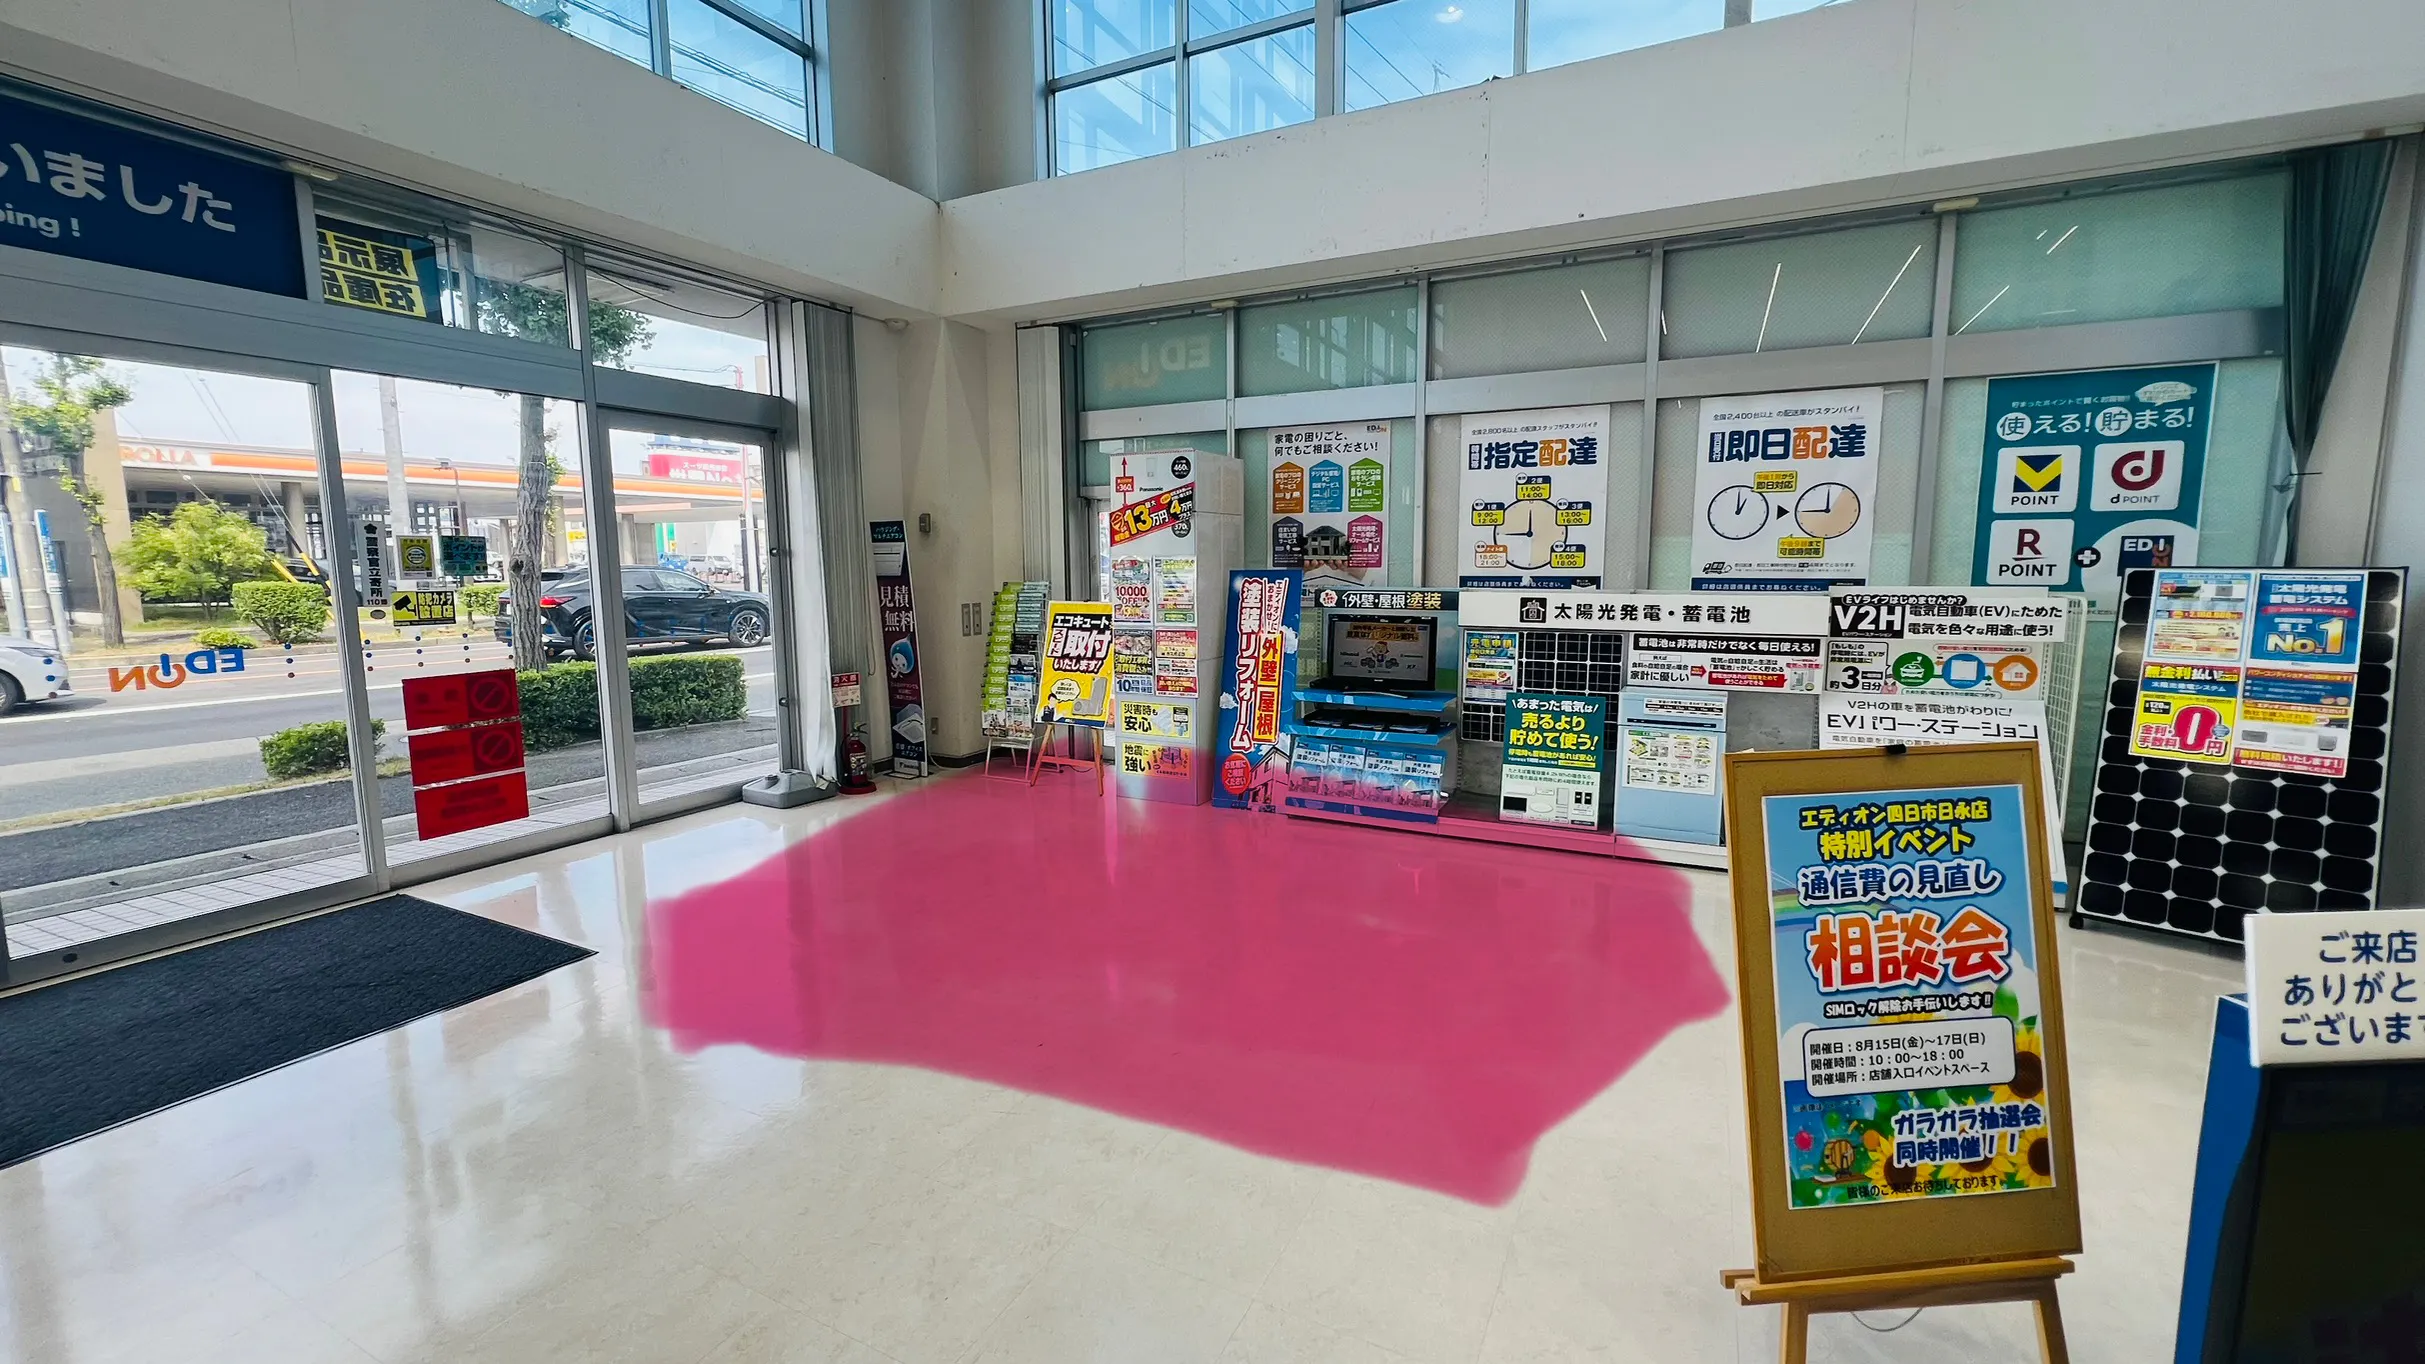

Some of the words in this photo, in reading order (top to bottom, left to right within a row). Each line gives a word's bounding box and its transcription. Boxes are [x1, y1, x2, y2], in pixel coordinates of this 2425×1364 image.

[1274, 441, 1378, 457] 何でもご相談ください!
[1484, 436, 1598, 470] 指定配達
[1725, 424, 1866, 462] 即日配達
[2011, 495, 2059, 506] POINT
[2122, 494, 2160, 504] POINT
[2016, 529, 2043, 556] R
[1998, 564, 2057, 577] POINT
[880, 586, 909, 608] 見積
[1845, 594, 1963, 606] EVライフはじめませんか?
[885, 610, 915, 632] 無料
[1053, 615, 1109, 628] エコキュート
[1554, 603, 1751, 624] 太陽光発電・蓄電池
[1834, 605, 1900, 631] V2H
[1908, 605, 2063, 618] 電気自動車(EV)にためた
[1907, 622, 2054, 637] 電気を色々な用途に使う!
[2267, 619, 2345, 654] No.1
[1063, 630, 1112, 658] 取付
[1231, 583, 1262, 749] 塗装リフォーム
[1260, 637, 1278, 682] 外壁
[1630, 670, 1690, 683] 家計に優しい
[1124, 704, 1158, 715] 災害時も
[1256, 690, 1275, 736] 屋根
[1516, 698, 1592, 713] あまった電気は
[1847, 700, 2013, 717] V2Hの車を蓄電池がわりに!
[1124, 716, 1152, 732] 安心
[1521, 712, 1586, 731] 売るより
[1124, 744, 1149, 756] 地震に
[1509, 729, 1599, 751] 貯めて使う!
[1124, 756, 1152, 772] 強い
[1801, 800, 1989, 828] エディオン四日市日永店
[1819, 827, 1972, 860] 特別イベント
[1800, 862, 1998, 902] 通信費の見直し
[1810, 910, 2006, 989] 相談会
[2284, 972, 2425, 1006] ありがと
[1894, 1105, 2043, 1137] ガラガラ抽選会
